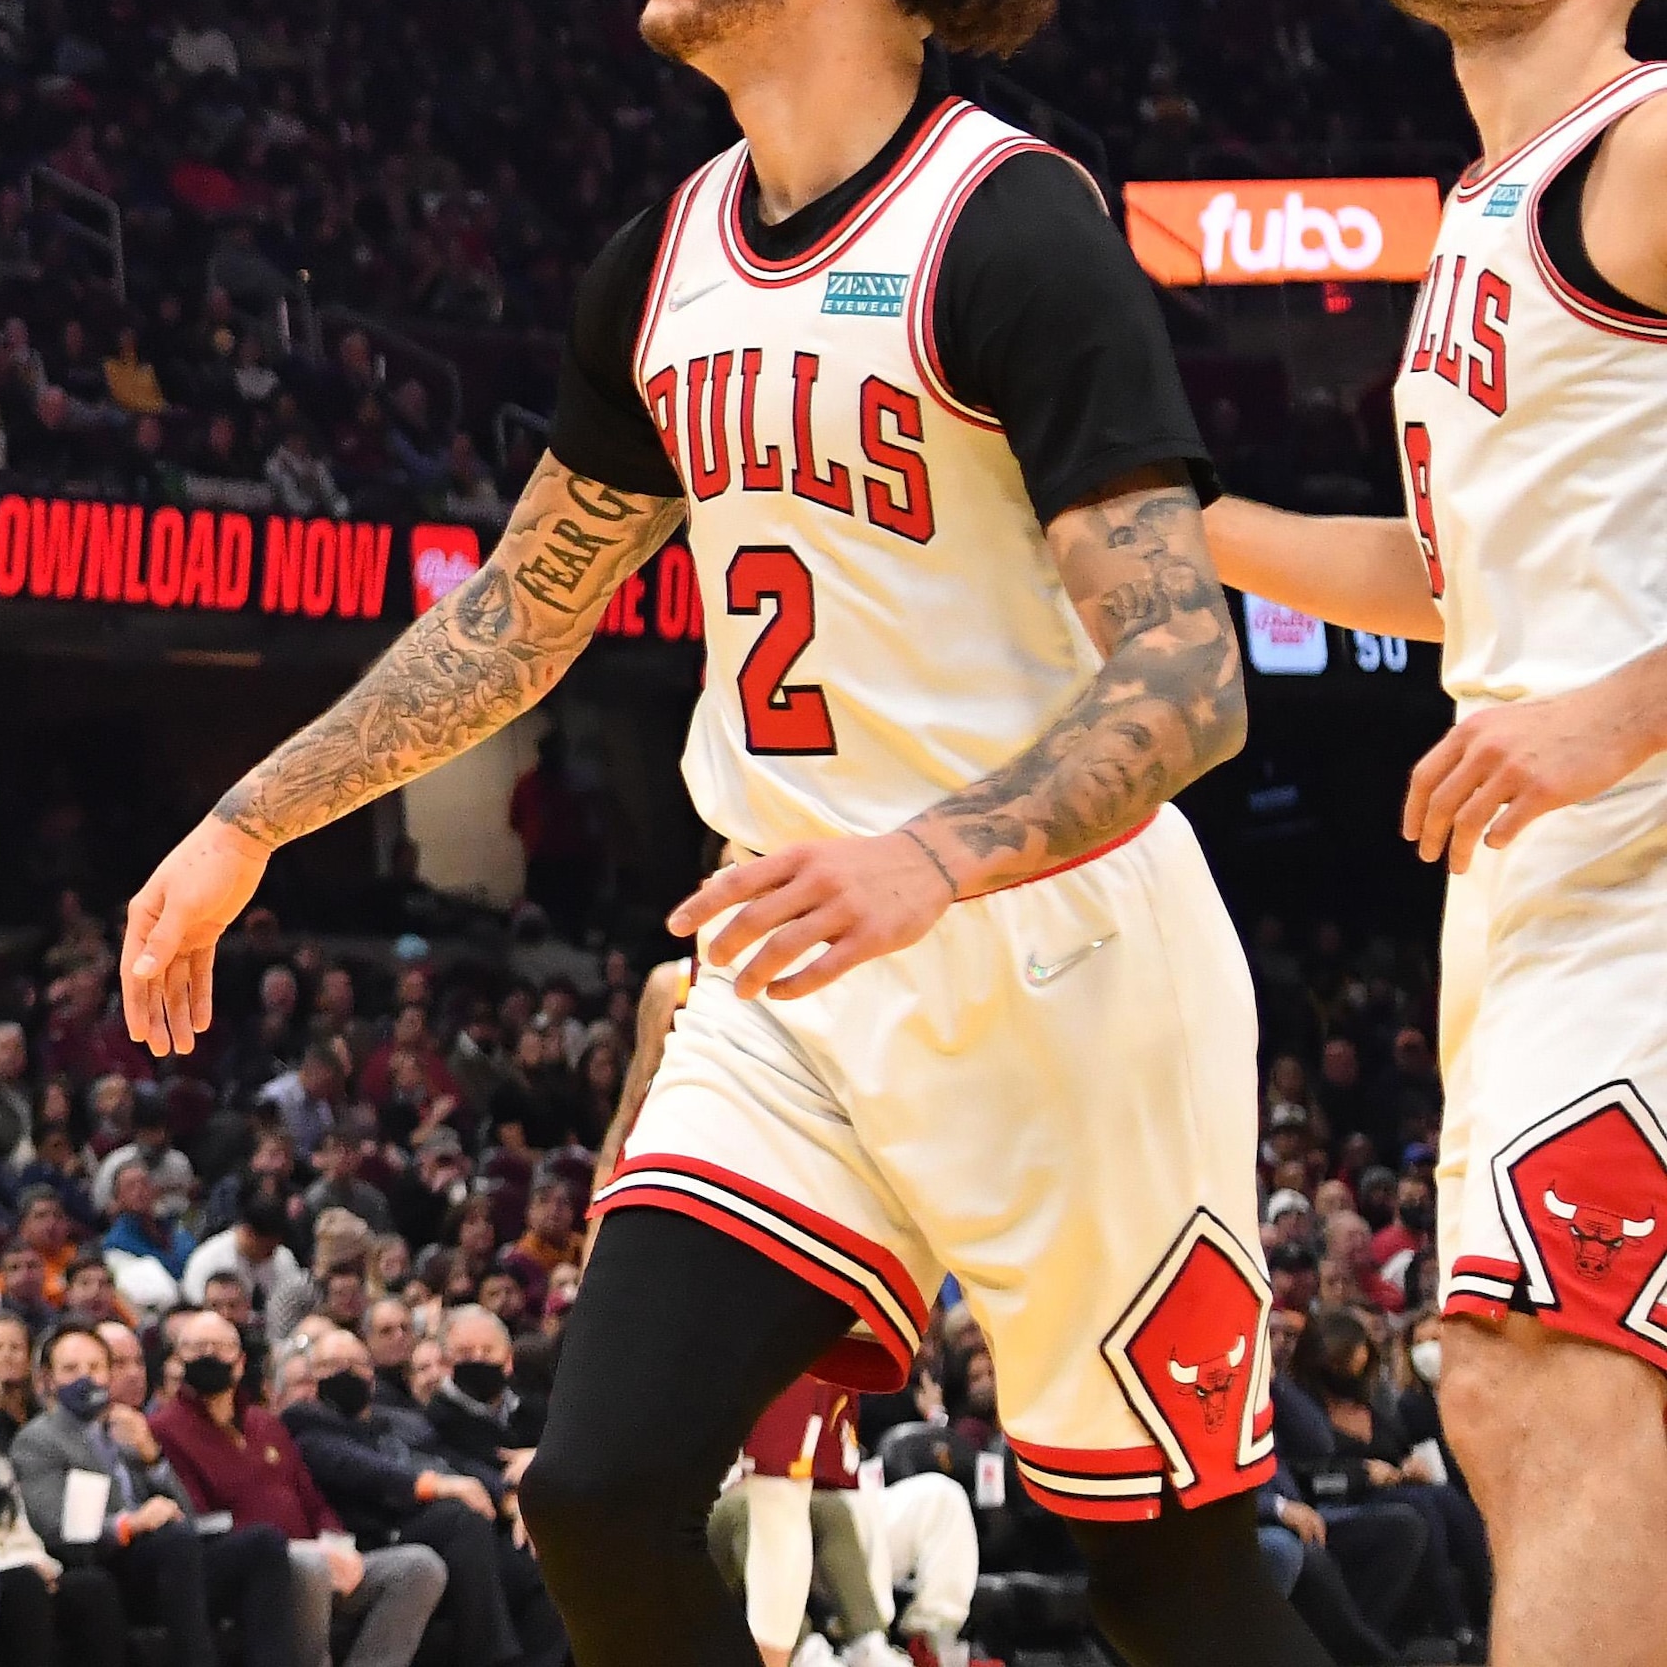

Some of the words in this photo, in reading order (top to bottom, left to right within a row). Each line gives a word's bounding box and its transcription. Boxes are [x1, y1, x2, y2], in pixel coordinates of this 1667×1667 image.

[1200, 191, 1383, 272] fubo
[824, 299, 902, 313] EYEWEAR
[829, 275, 909, 297] ZENNI
[1411, 254, 1512, 418] LLS
[264, 518, 393, 618] NOW
[726, 545, 838, 756] 2
